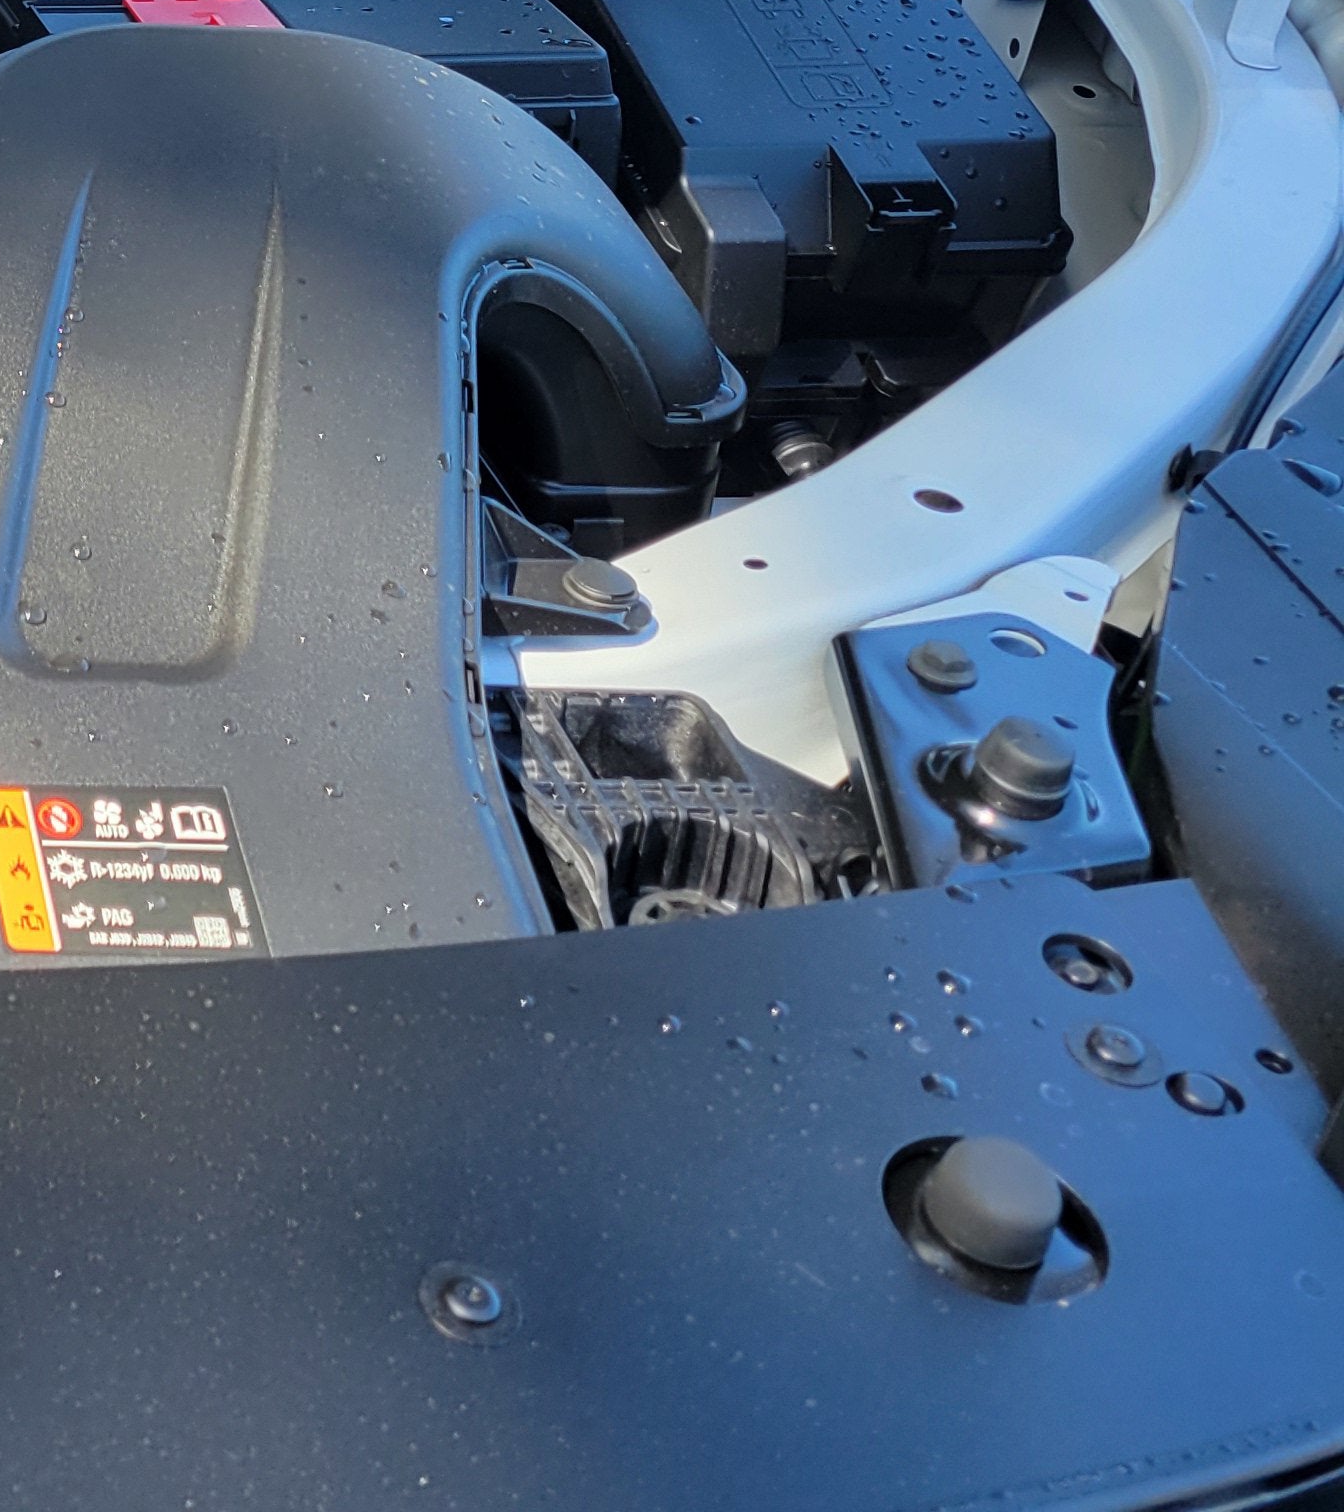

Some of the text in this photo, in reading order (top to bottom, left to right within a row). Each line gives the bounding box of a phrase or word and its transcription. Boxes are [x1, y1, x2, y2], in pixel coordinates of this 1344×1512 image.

[95, 824, 130, 840] AUTO
[90, 860, 154, 884] R-1234yf
[200, 863, 223, 885] kg
[101, 907, 135, 928] PAG
